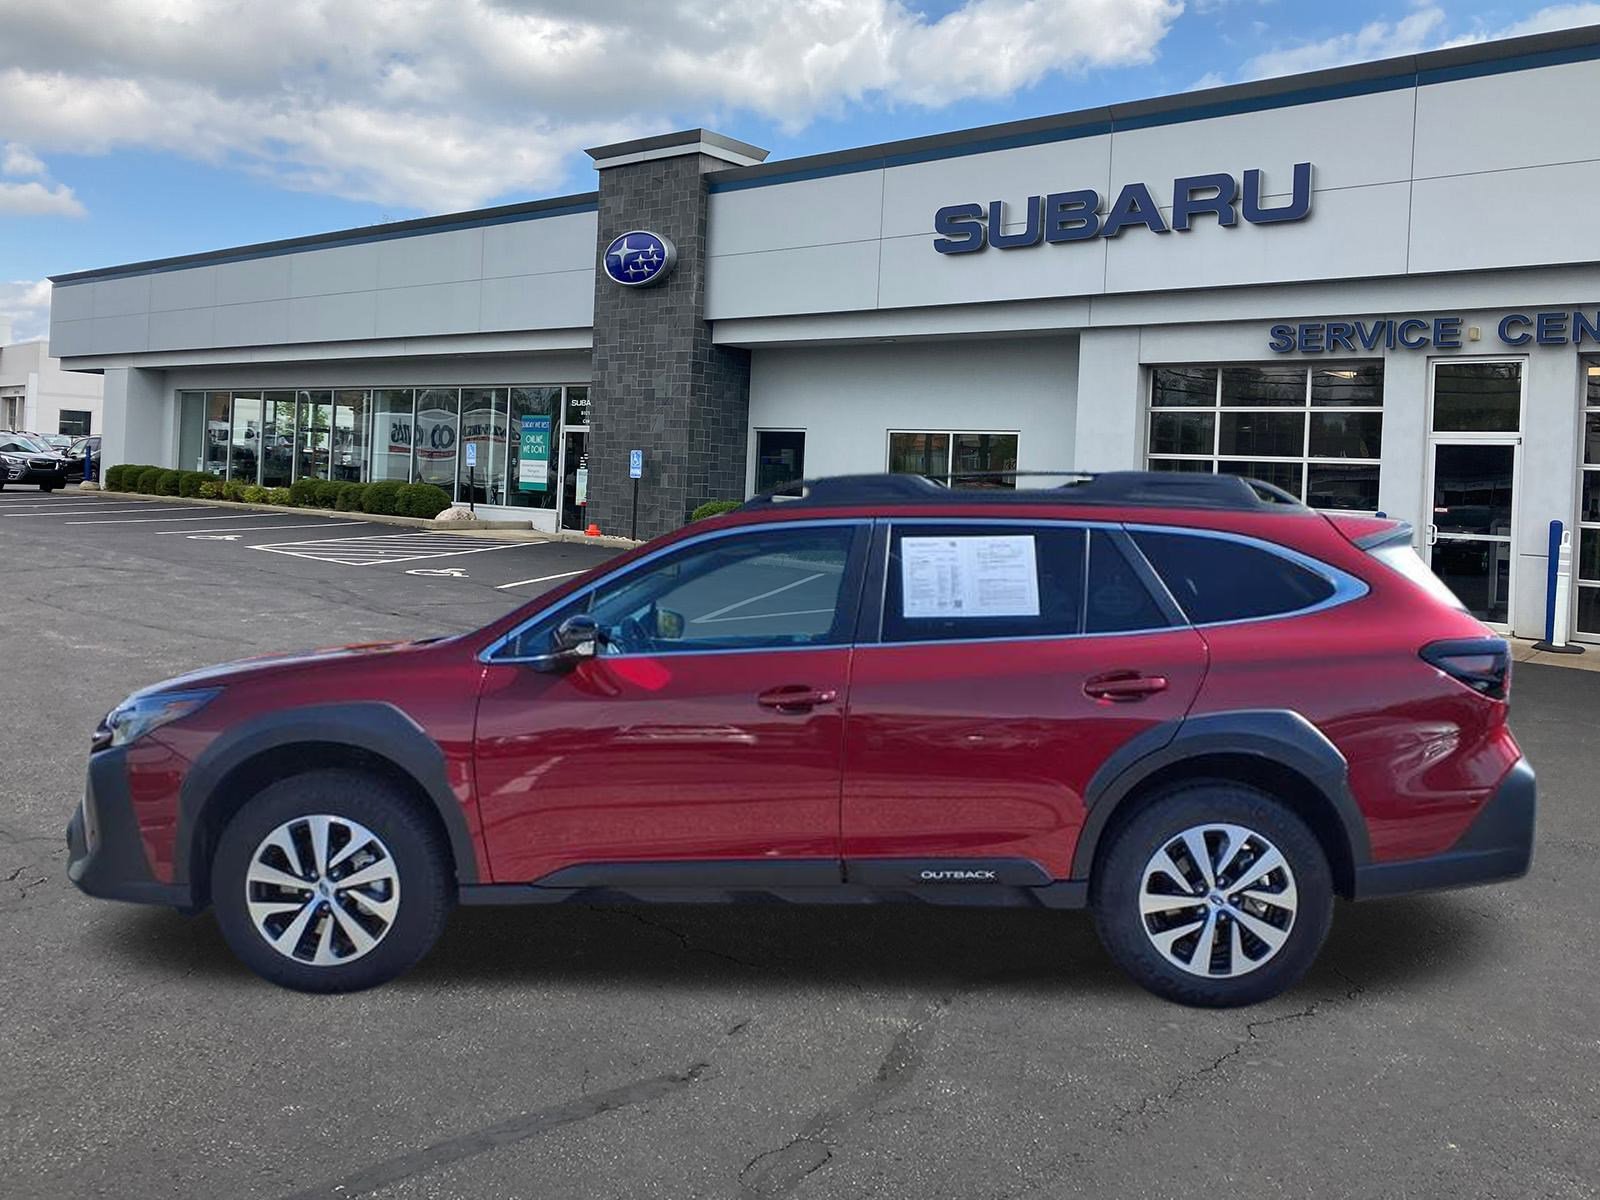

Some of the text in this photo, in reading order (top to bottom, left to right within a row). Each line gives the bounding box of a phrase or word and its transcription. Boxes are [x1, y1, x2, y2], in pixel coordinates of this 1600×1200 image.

[933, 161, 1314, 255] SUBARU
[1268, 310, 1600, 352] SERVICE CEN
[920, 870, 995, 879] OUTBACK
